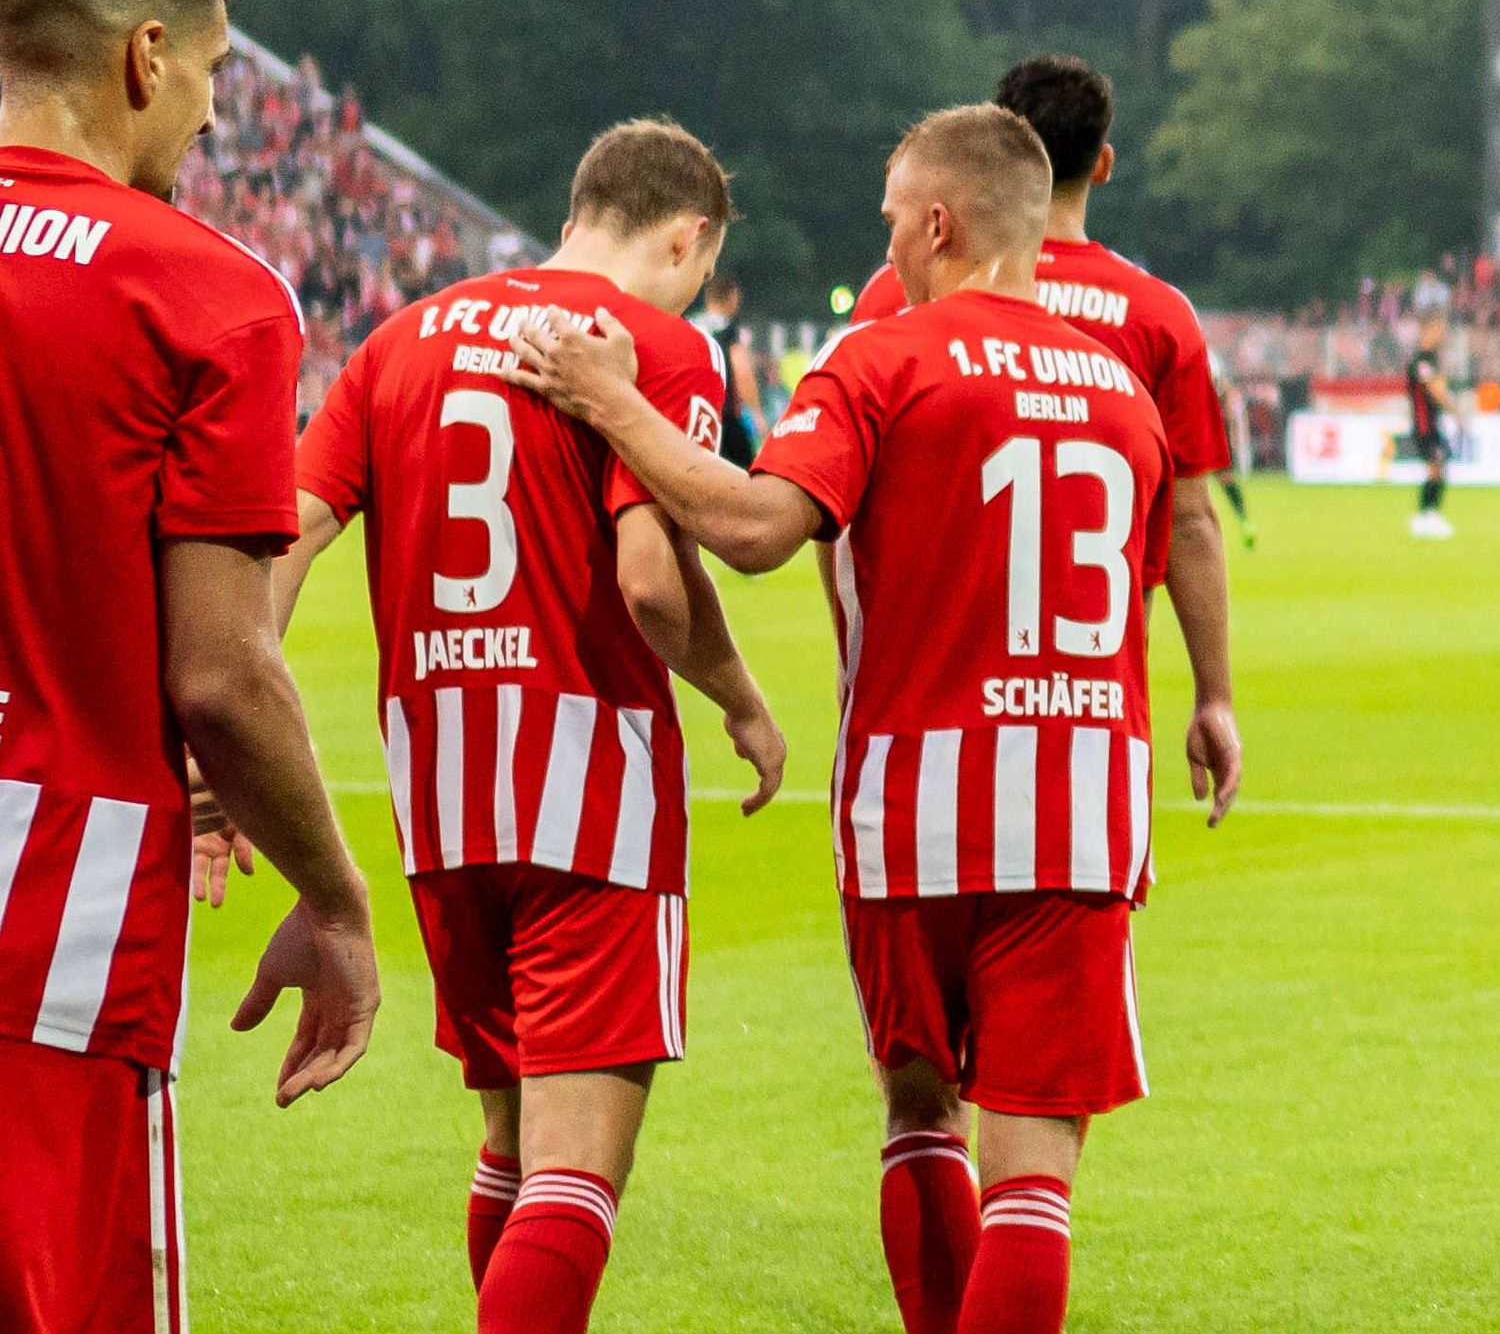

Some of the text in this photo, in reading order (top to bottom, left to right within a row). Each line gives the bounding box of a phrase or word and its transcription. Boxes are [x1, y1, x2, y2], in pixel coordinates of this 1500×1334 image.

[442, 298, 491, 335] FC
[452, 344, 520, 375] BERLIN
[948, 337, 1135, 398] 1. FC UNION
[1015, 391, 1089, 424] BERLIN
[433, 388, 517, 614] 3
[981, 435, 1135, 658] 13
[412, 625, 538, 681] JAECKEL
[983, 671, 1124, 720] SCHÄFER
